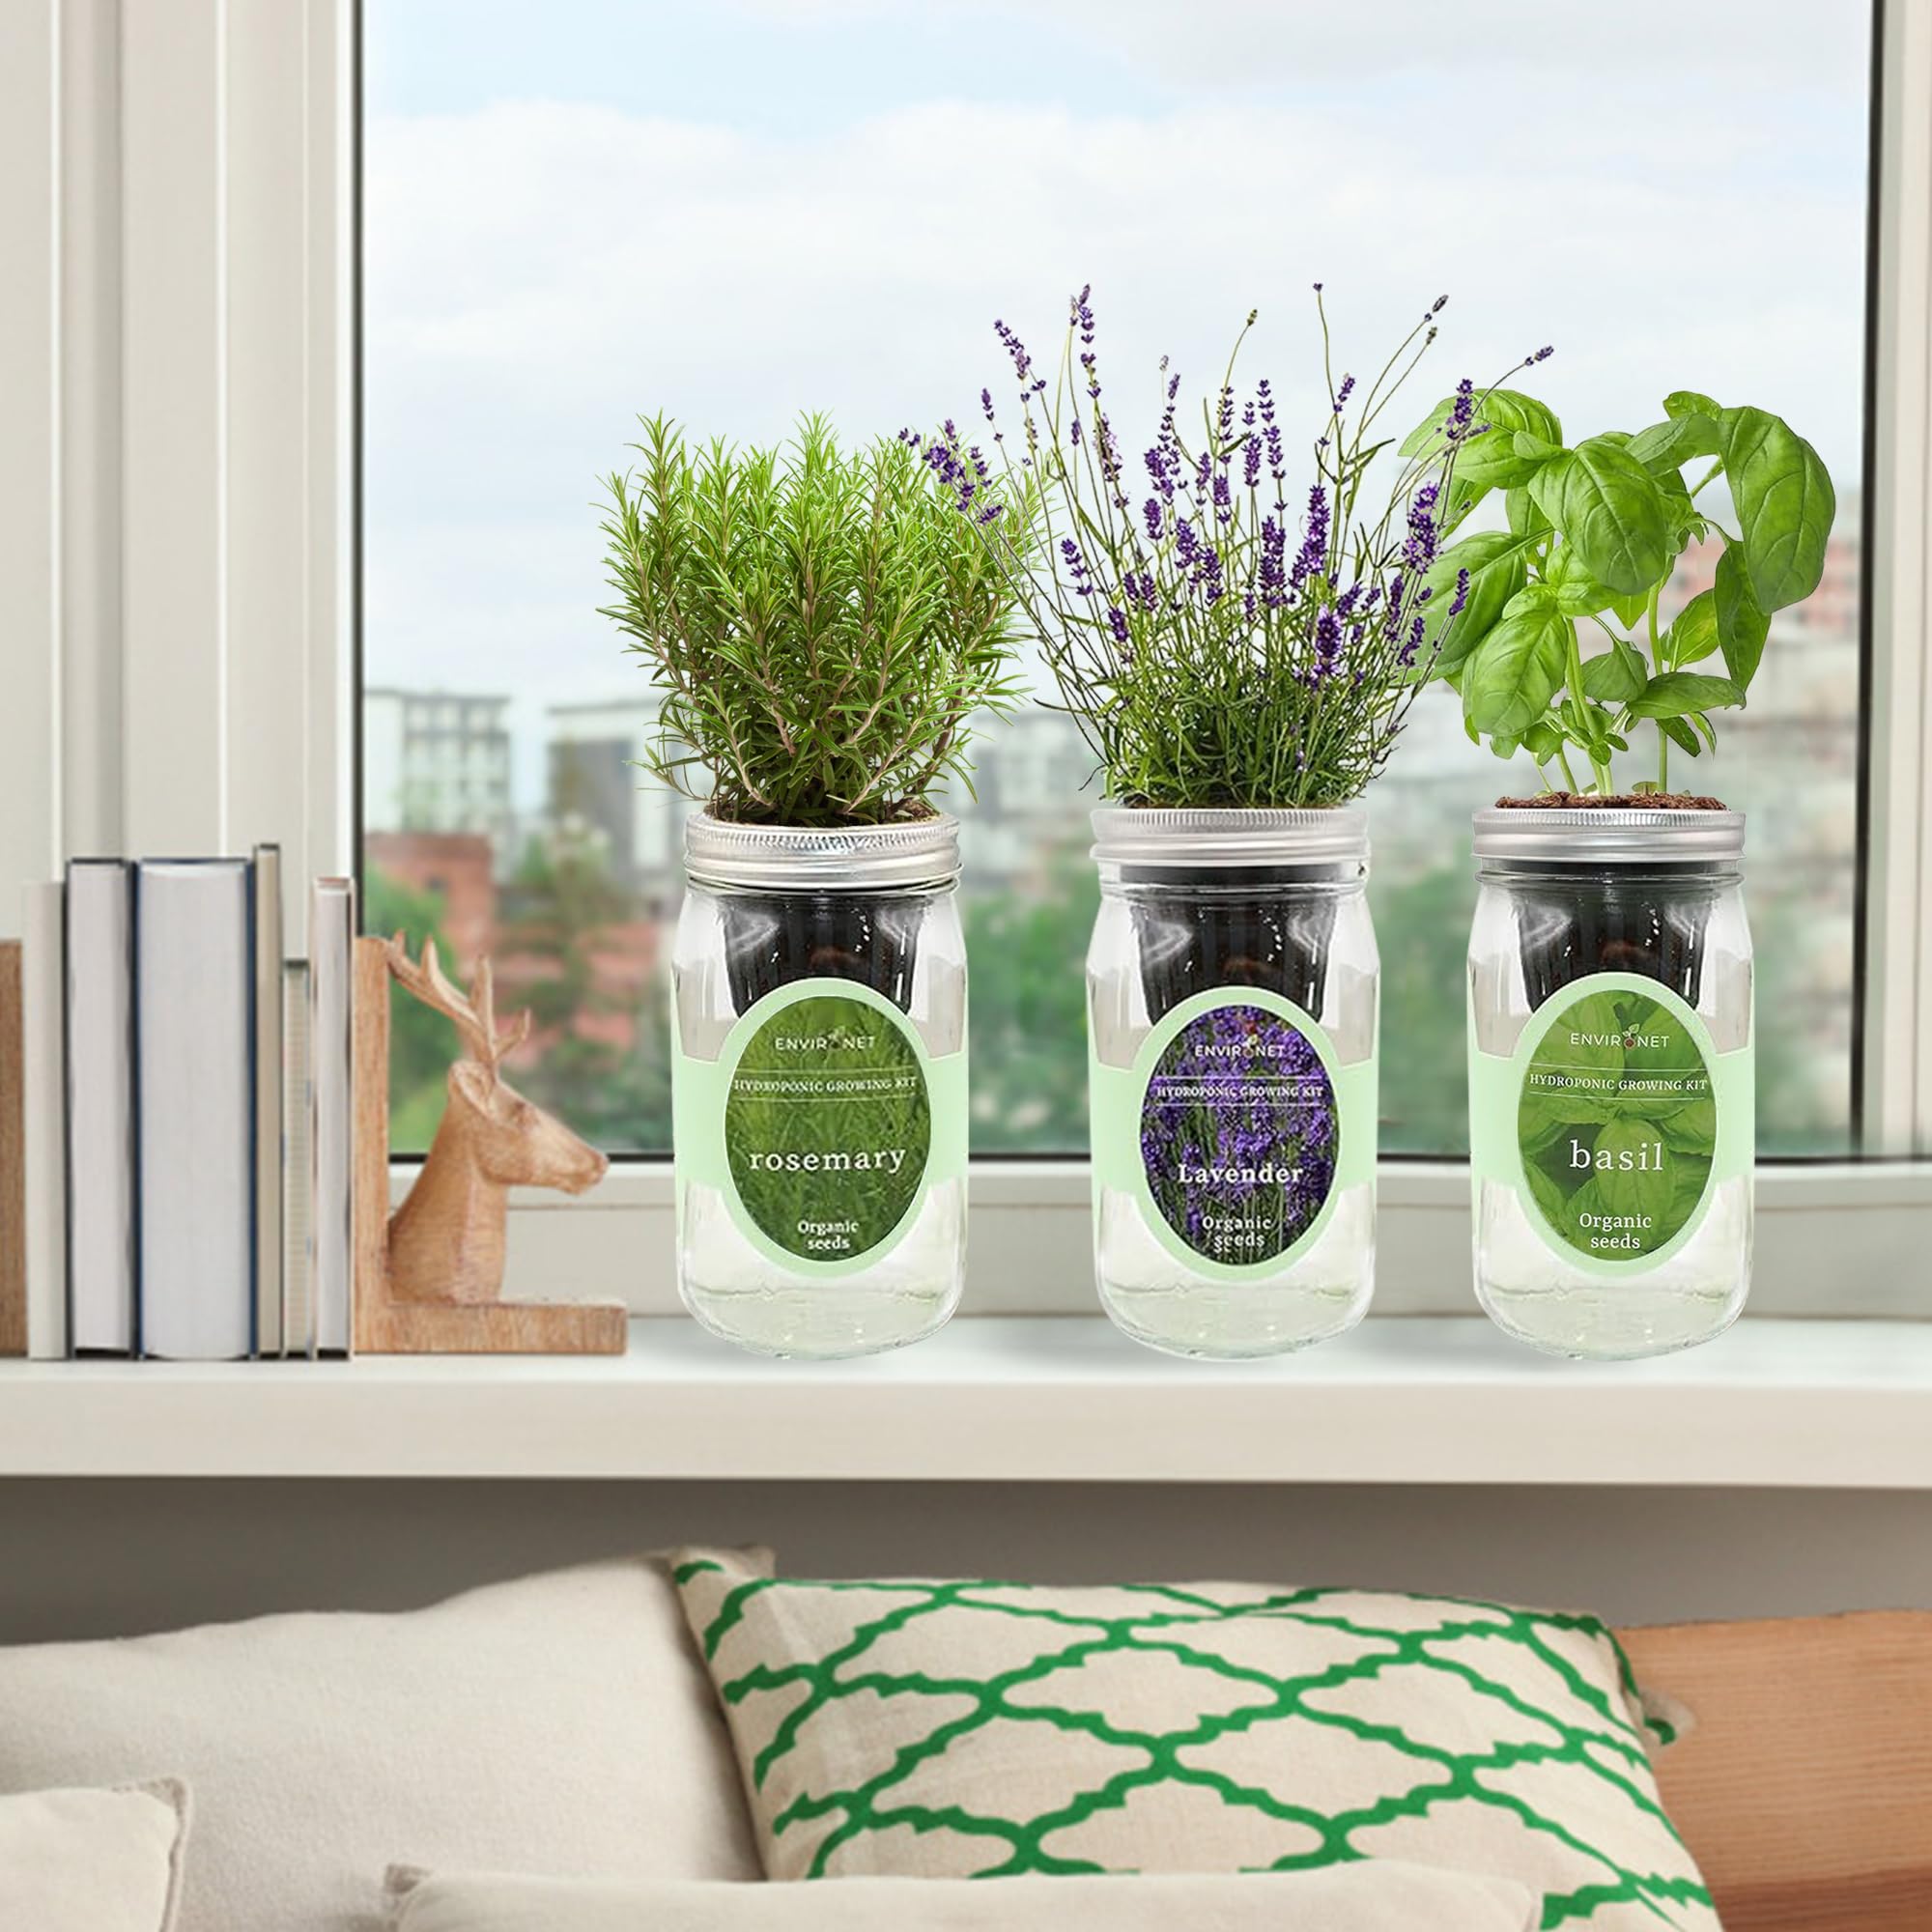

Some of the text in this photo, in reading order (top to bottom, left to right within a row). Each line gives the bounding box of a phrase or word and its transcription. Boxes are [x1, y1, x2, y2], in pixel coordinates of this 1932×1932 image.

[1570, 1031, 1669, 1049] ENVIRONET
[734, 1078, 823, 1094] HYDROPONIC
[826, 1079, 892, 1094] GROWING
[1529, 1073, 1708, 1092] HYDROPONIC GROWING KIT
[1157, 1086, 1323, 1098] HYDROPONIC GROWING KIT
[750, 1149, 906, 1175] rosemary
[1569, 1140, 1663, 1171] basil
[1178, 1163, 1303, 1184] Lavender
[797, 1220, 859, 1236] Organic
[1202, 1215, 1272, 1232] Organic
[1578, 1212, 1652, 1232] Organic
[807, 1236, 850, 1250] seeds
[1212, 1232, 1265, 1247] seeds
[1590, 1234, 1640, 1249] seeds
